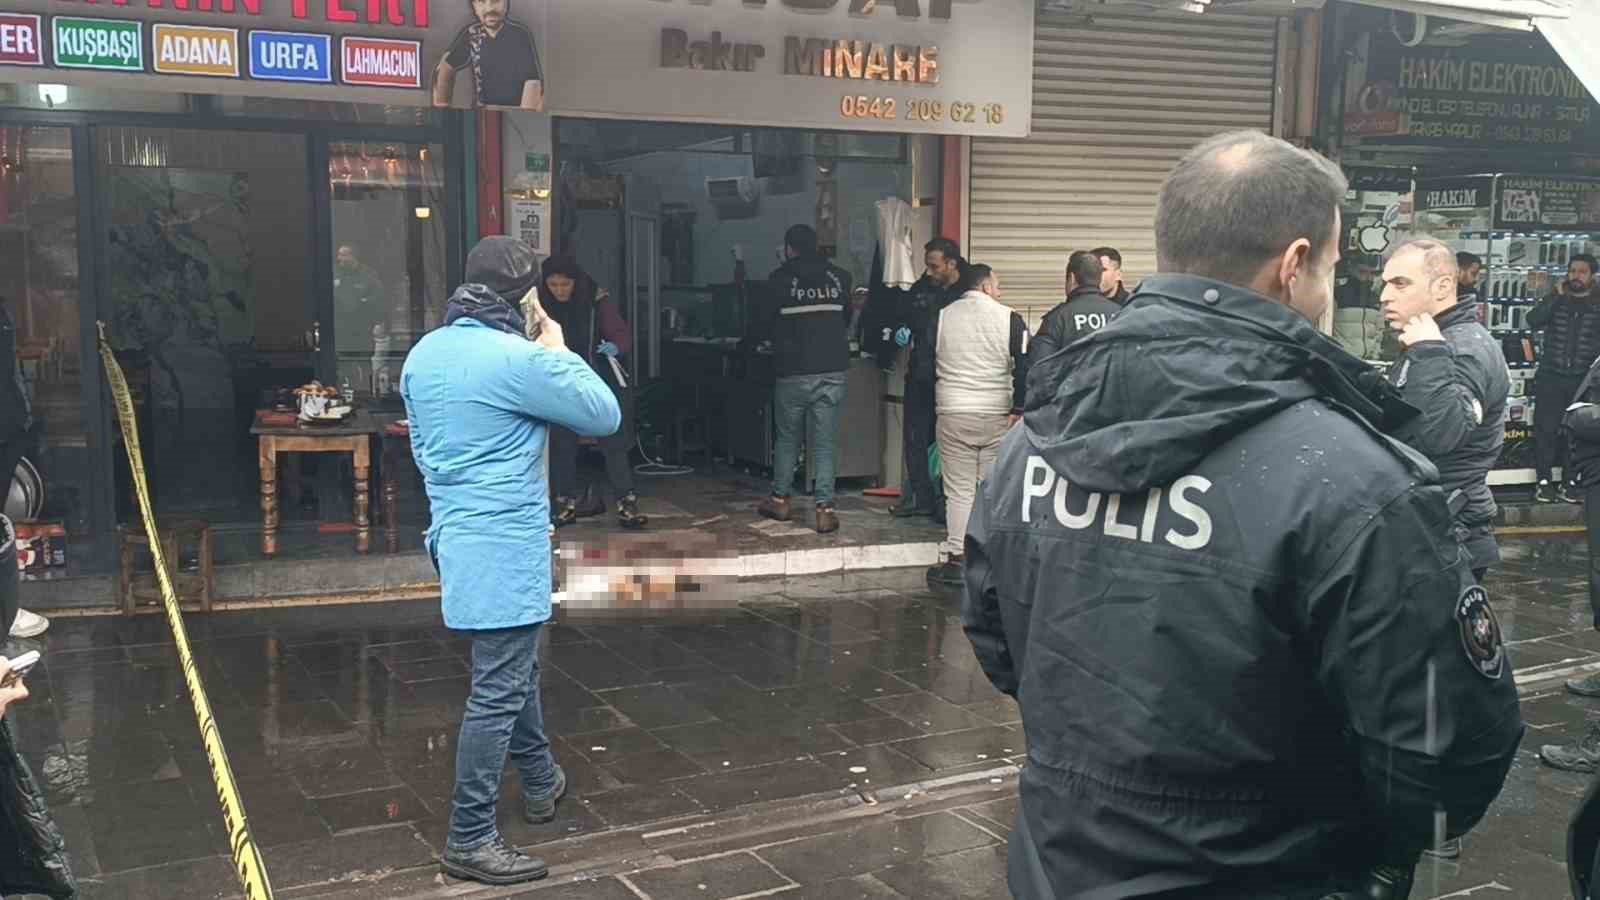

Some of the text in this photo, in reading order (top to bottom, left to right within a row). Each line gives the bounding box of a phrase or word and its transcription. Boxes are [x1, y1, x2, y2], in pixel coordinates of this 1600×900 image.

[0, 24, 36, 54] ER
[58, 26, 138, 65] KUŞBAŞI
[160, 35, 232, 67] ADANA
[260, 41, 319, 71] URFA
[345, 46, 417, 77] LAHMACUN
[839, 94, 897, 120] 0542
[949, 101, 976, 123] 62
[982, 103, 1005, 125] 18
